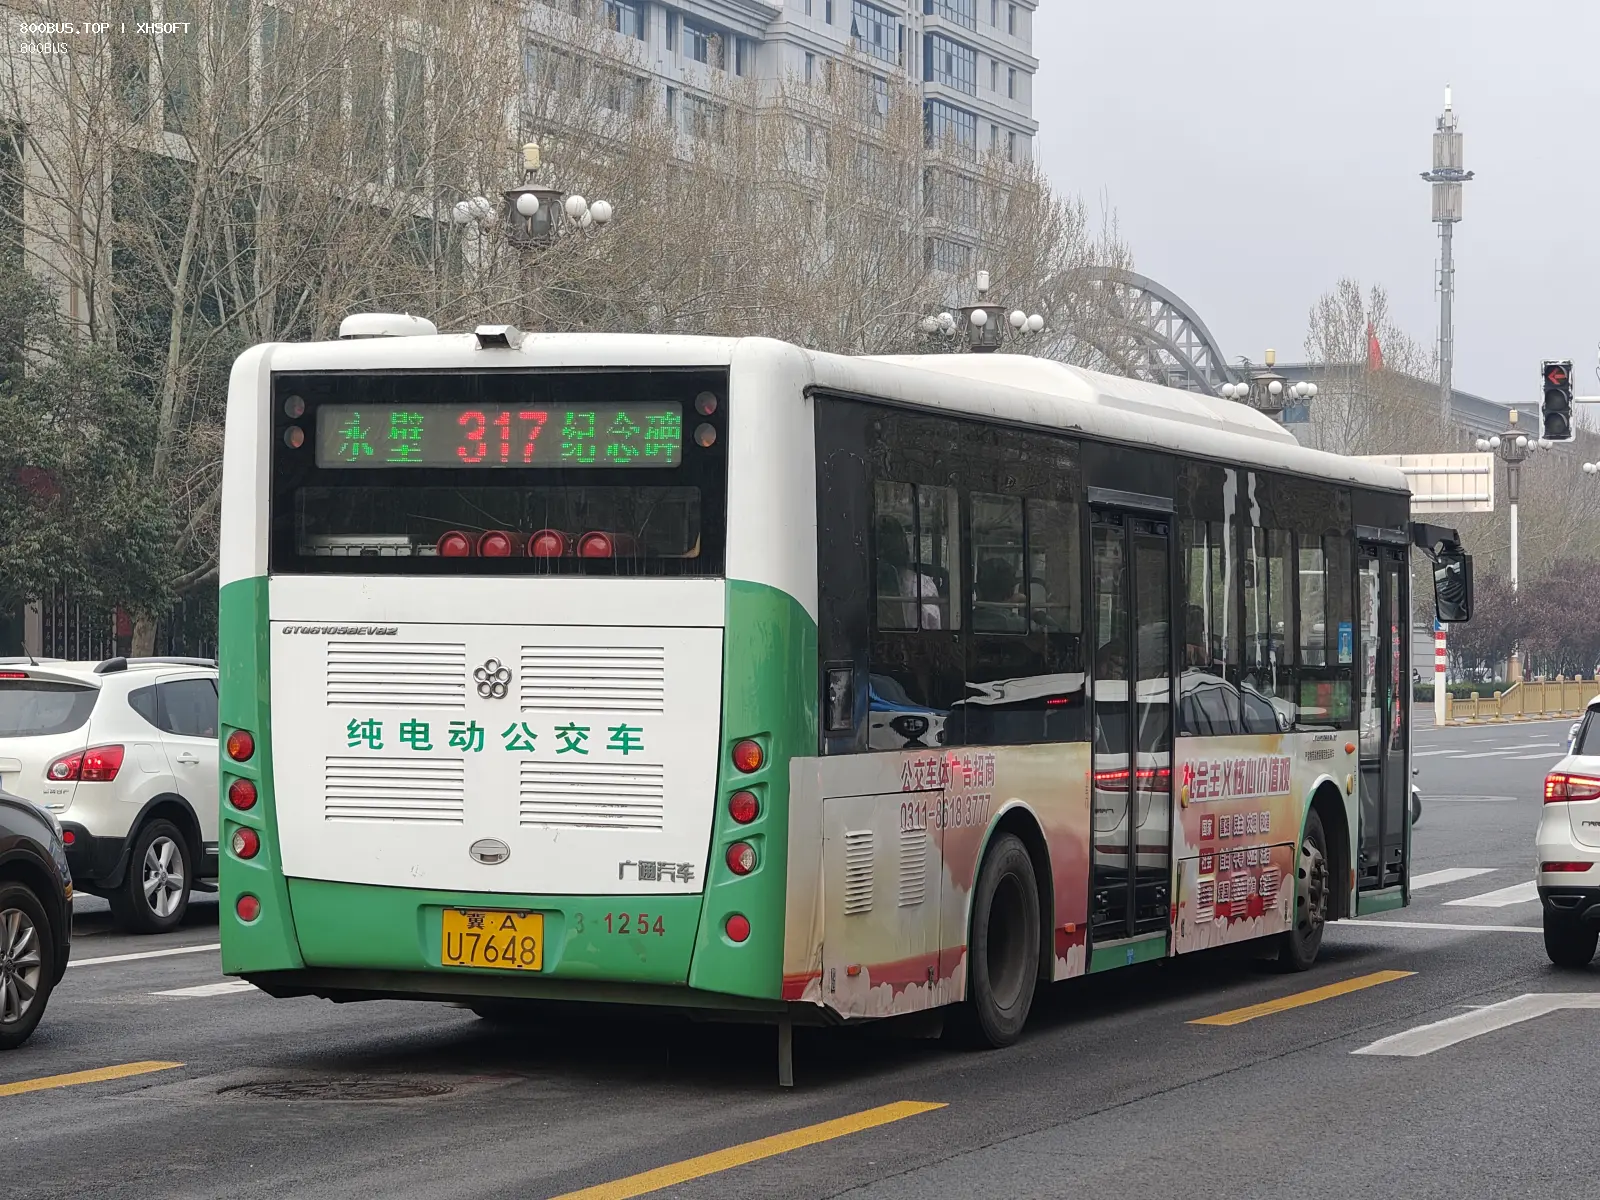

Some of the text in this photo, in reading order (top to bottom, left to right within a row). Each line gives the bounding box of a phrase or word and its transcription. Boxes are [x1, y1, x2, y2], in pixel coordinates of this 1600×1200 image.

[456, 411, 548, 463] 317
[561, 411, 682, 463] 纪念碑
[346, 717, 645, 756] 纯电动公交车
[900, 752, 996, 793] 公交车体广告招商
[1183, 756, 1291, 799] 社会主义核心价值观
[618, 860, 695, 884] 广通汽车
[446, 931, 536, 966] U7648
